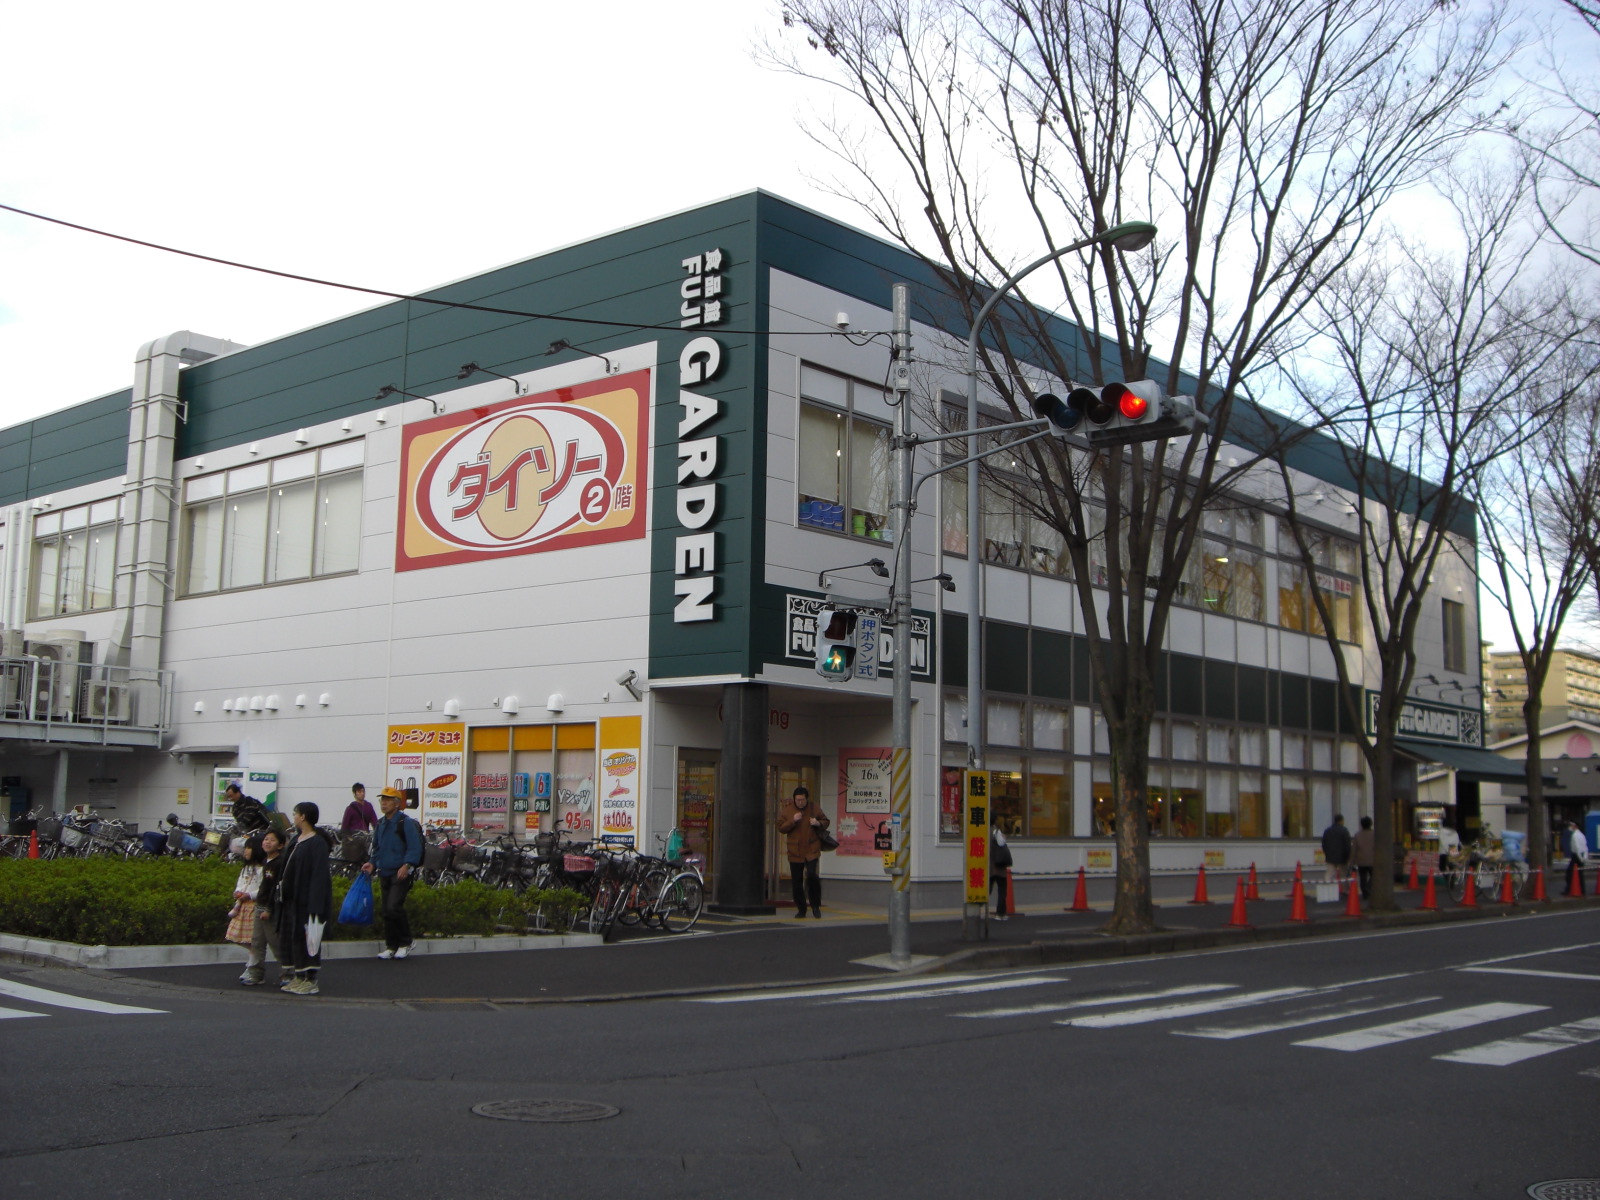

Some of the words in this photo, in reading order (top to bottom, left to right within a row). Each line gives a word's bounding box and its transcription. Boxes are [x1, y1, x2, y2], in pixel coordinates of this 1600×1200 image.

[680, 254, 702, 328] FUJI
[447, 439, 603, 522] ダイソー
[674, 336, 721, 623] GARDEN
[792, 616, 817, 633] 食品
[858, 618, 876, 677] 押ボタン式
[390, 729, 436, 747] クリーニング
[438, 731, 461, 745] ミユキ
[1414, 708, 1459, 738] GARDEN
[472, 774, 509, 790] 即日仕上げ
[861, 768, 879, 780] 16th
[969, 775, 986, 889] 駐車厳禁
